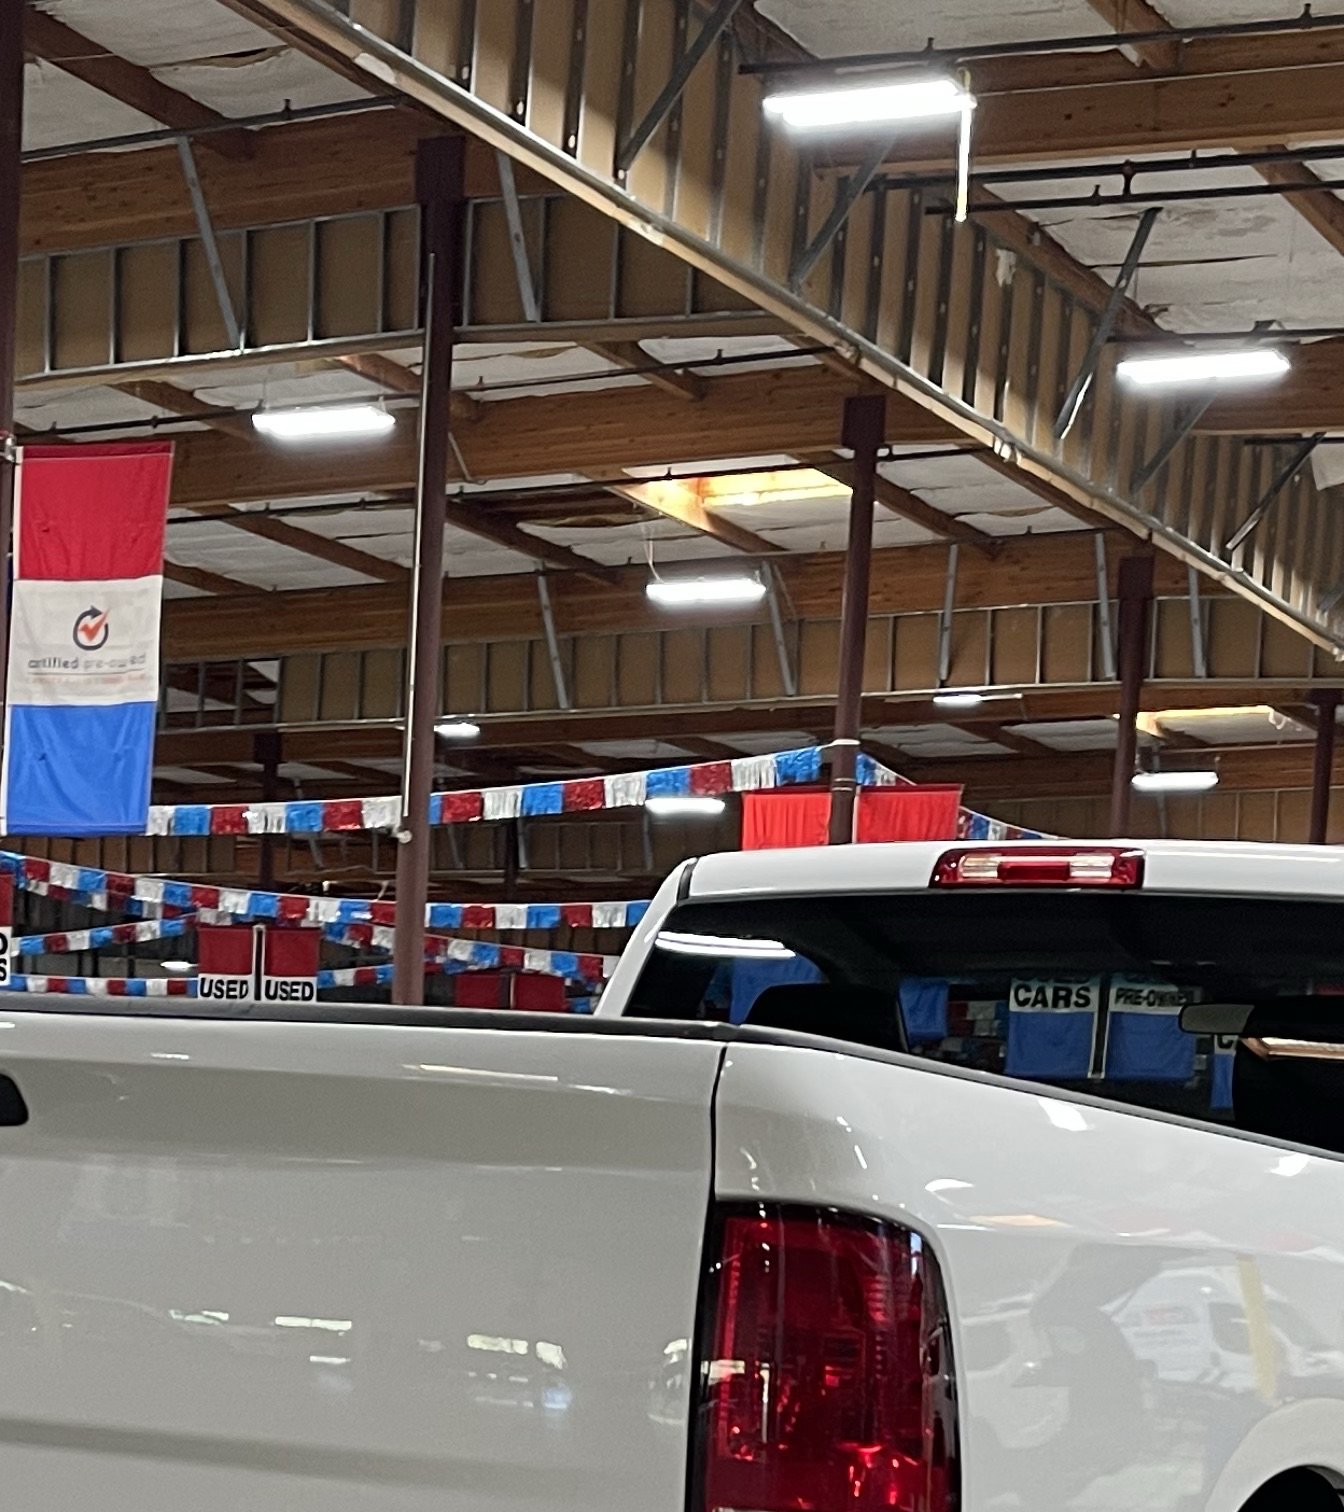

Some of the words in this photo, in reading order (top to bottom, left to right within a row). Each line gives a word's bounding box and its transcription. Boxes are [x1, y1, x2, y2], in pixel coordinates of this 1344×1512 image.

[199, 977, 248, 1000] USED
[264, 979, 314, 1001] USED
[1014, 983, 1091, 1009] CARS
